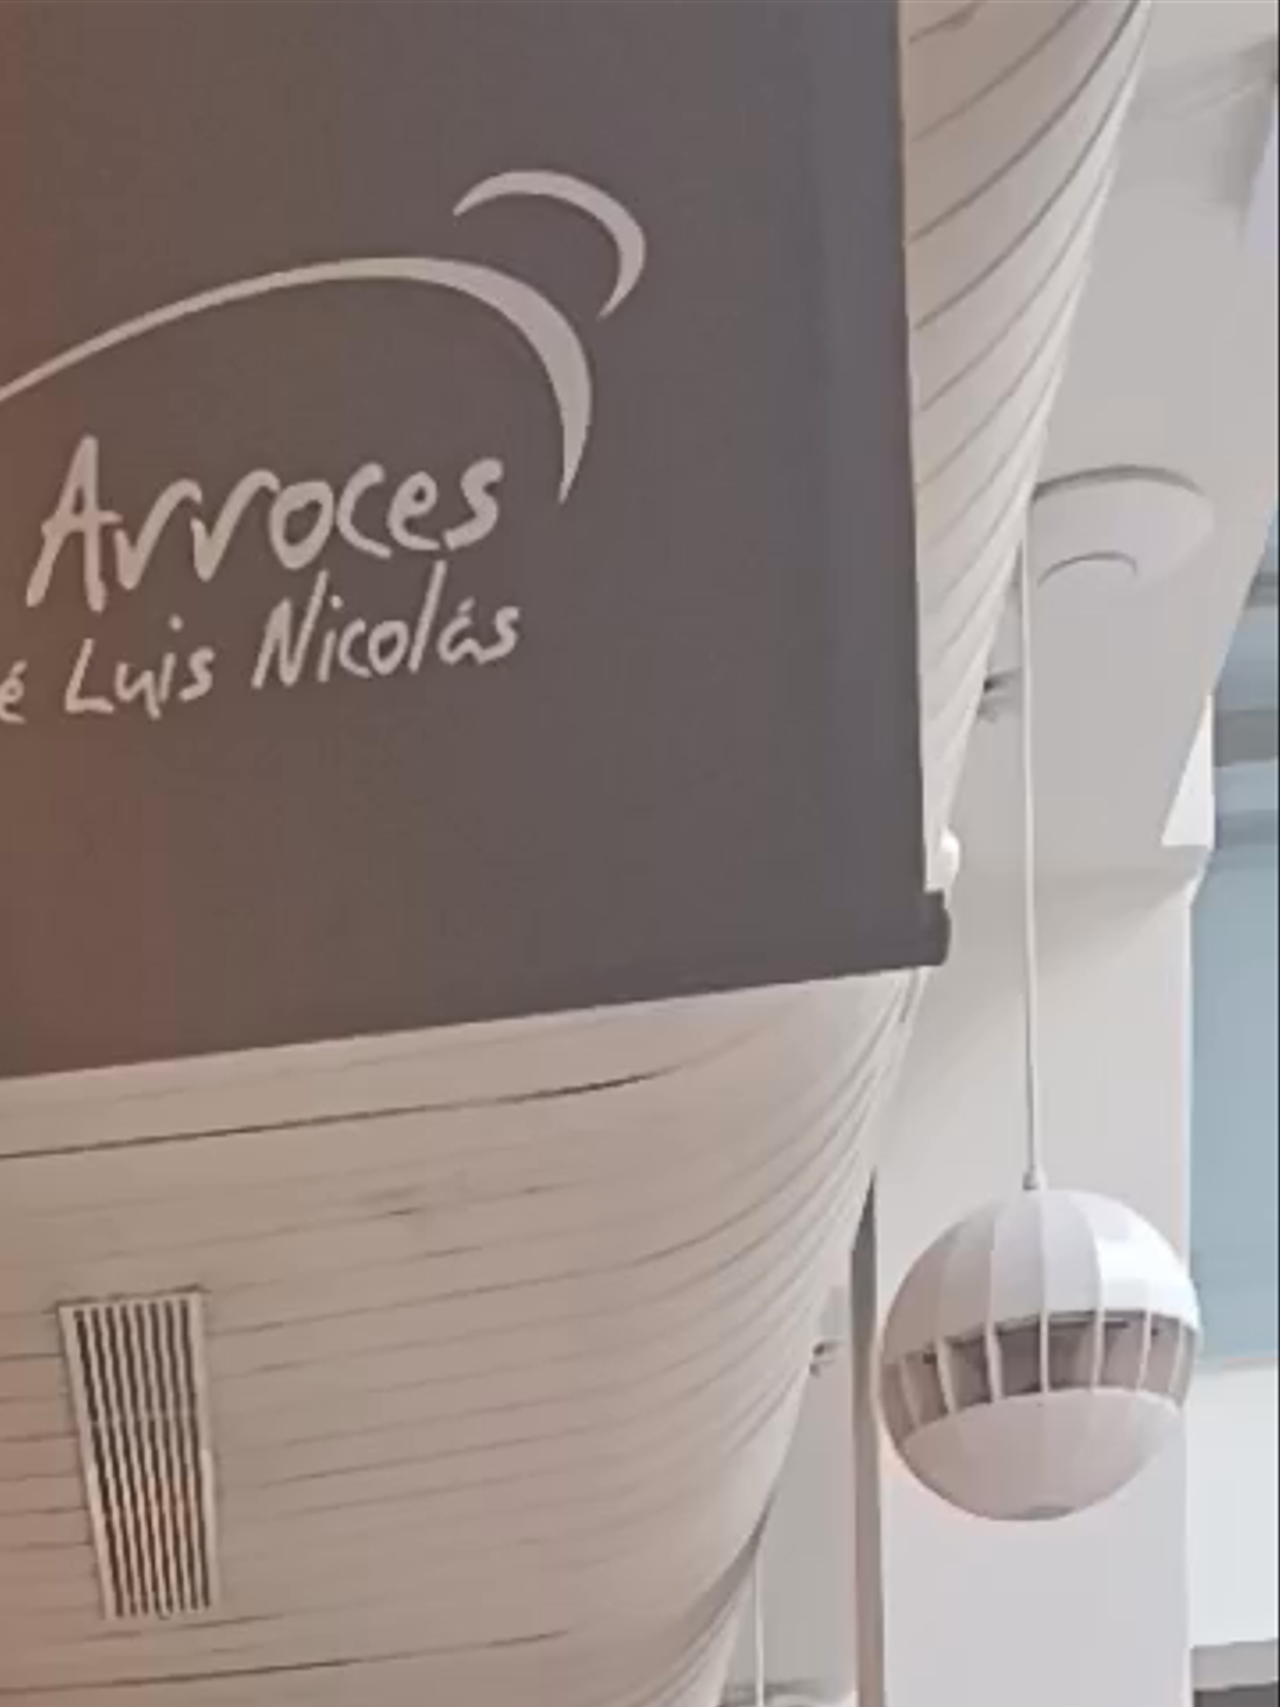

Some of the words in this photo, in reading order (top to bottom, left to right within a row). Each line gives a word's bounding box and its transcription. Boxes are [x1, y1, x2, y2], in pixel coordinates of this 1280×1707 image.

[24, 435, 505, 613] Arroces
[63, 613, 215, 720] Luis
[251, 558, 522, 690] Nicolás
